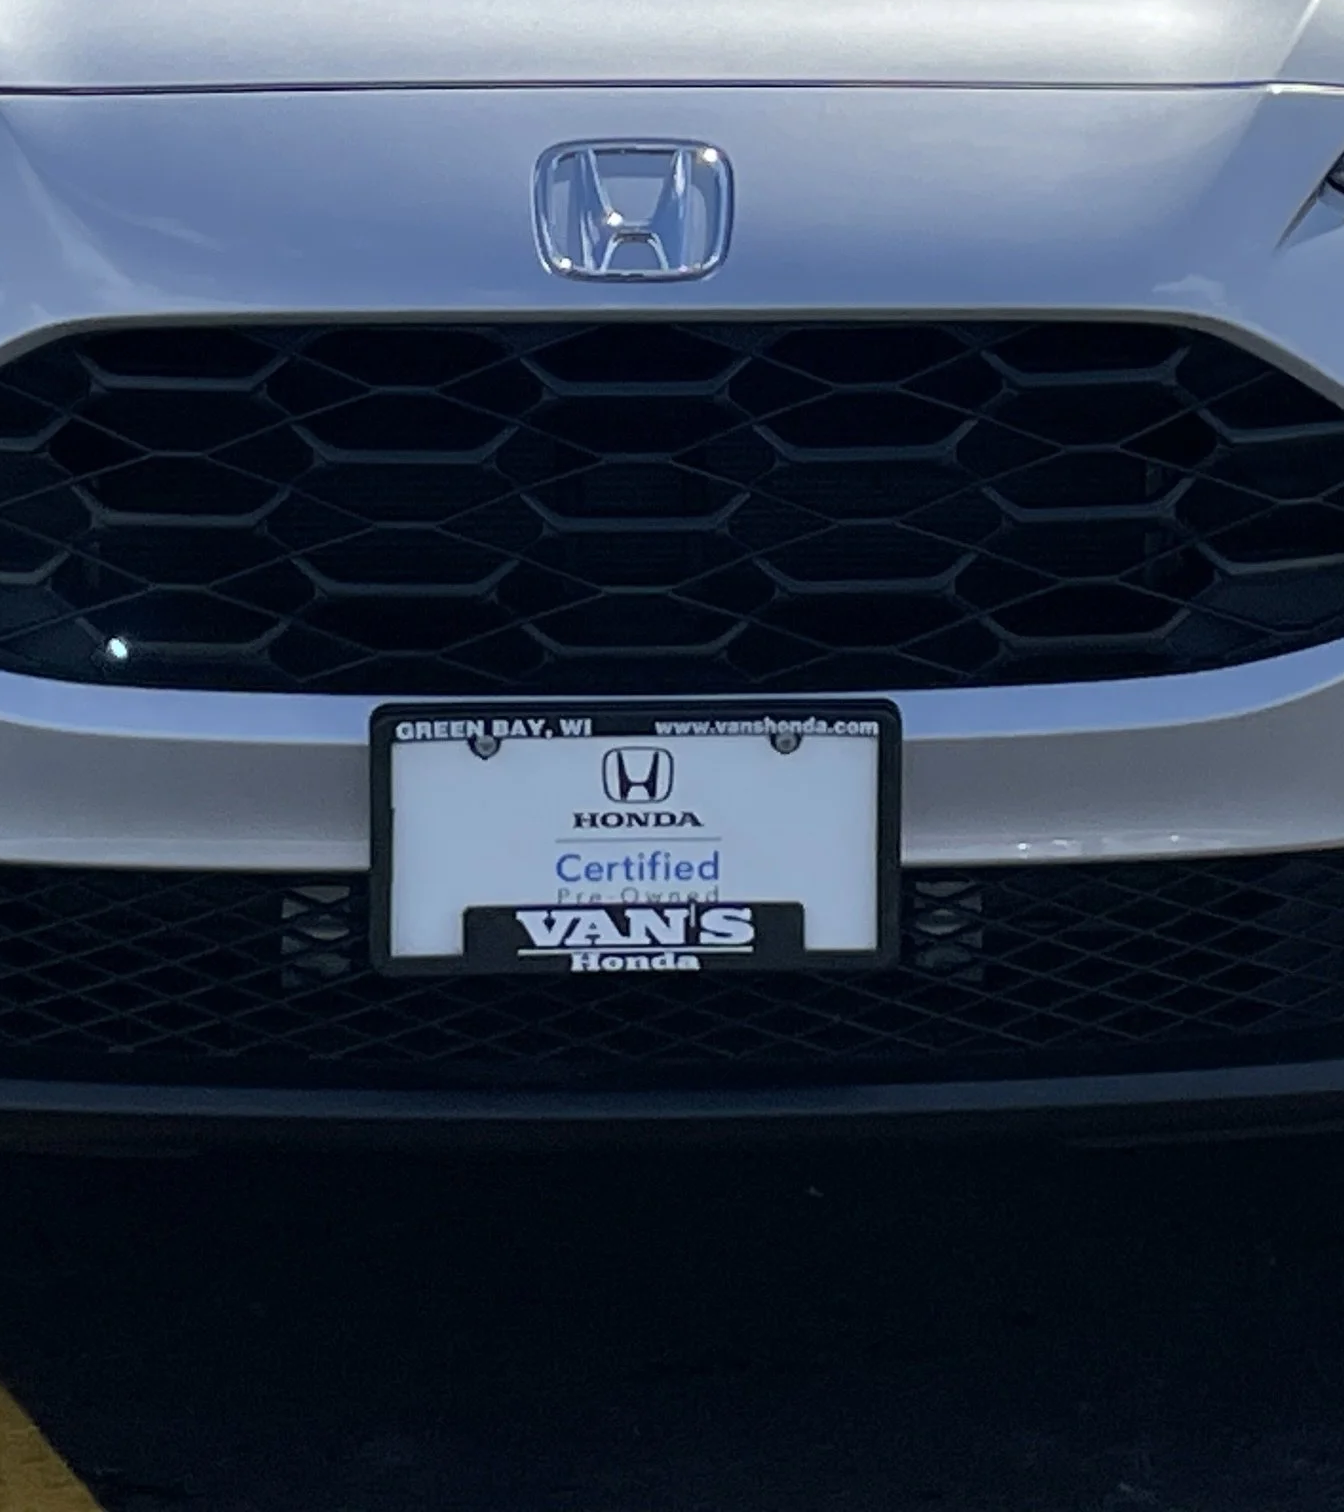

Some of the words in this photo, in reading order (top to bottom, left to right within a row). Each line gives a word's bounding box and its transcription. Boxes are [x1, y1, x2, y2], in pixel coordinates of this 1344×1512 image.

[395, 720, 485, 739] GREEN
[492, 719, 553, 739] BAY,
[560, 719, 592, 737] WI
[654, 717, 879, 735] www.vanshonda.com
[572, 811, 704, 829] HONDA
[556, 851, 719, 882] Certified
[516, 904, 754, 947] VAN'S
[570, 951, 701, 972] Honda
